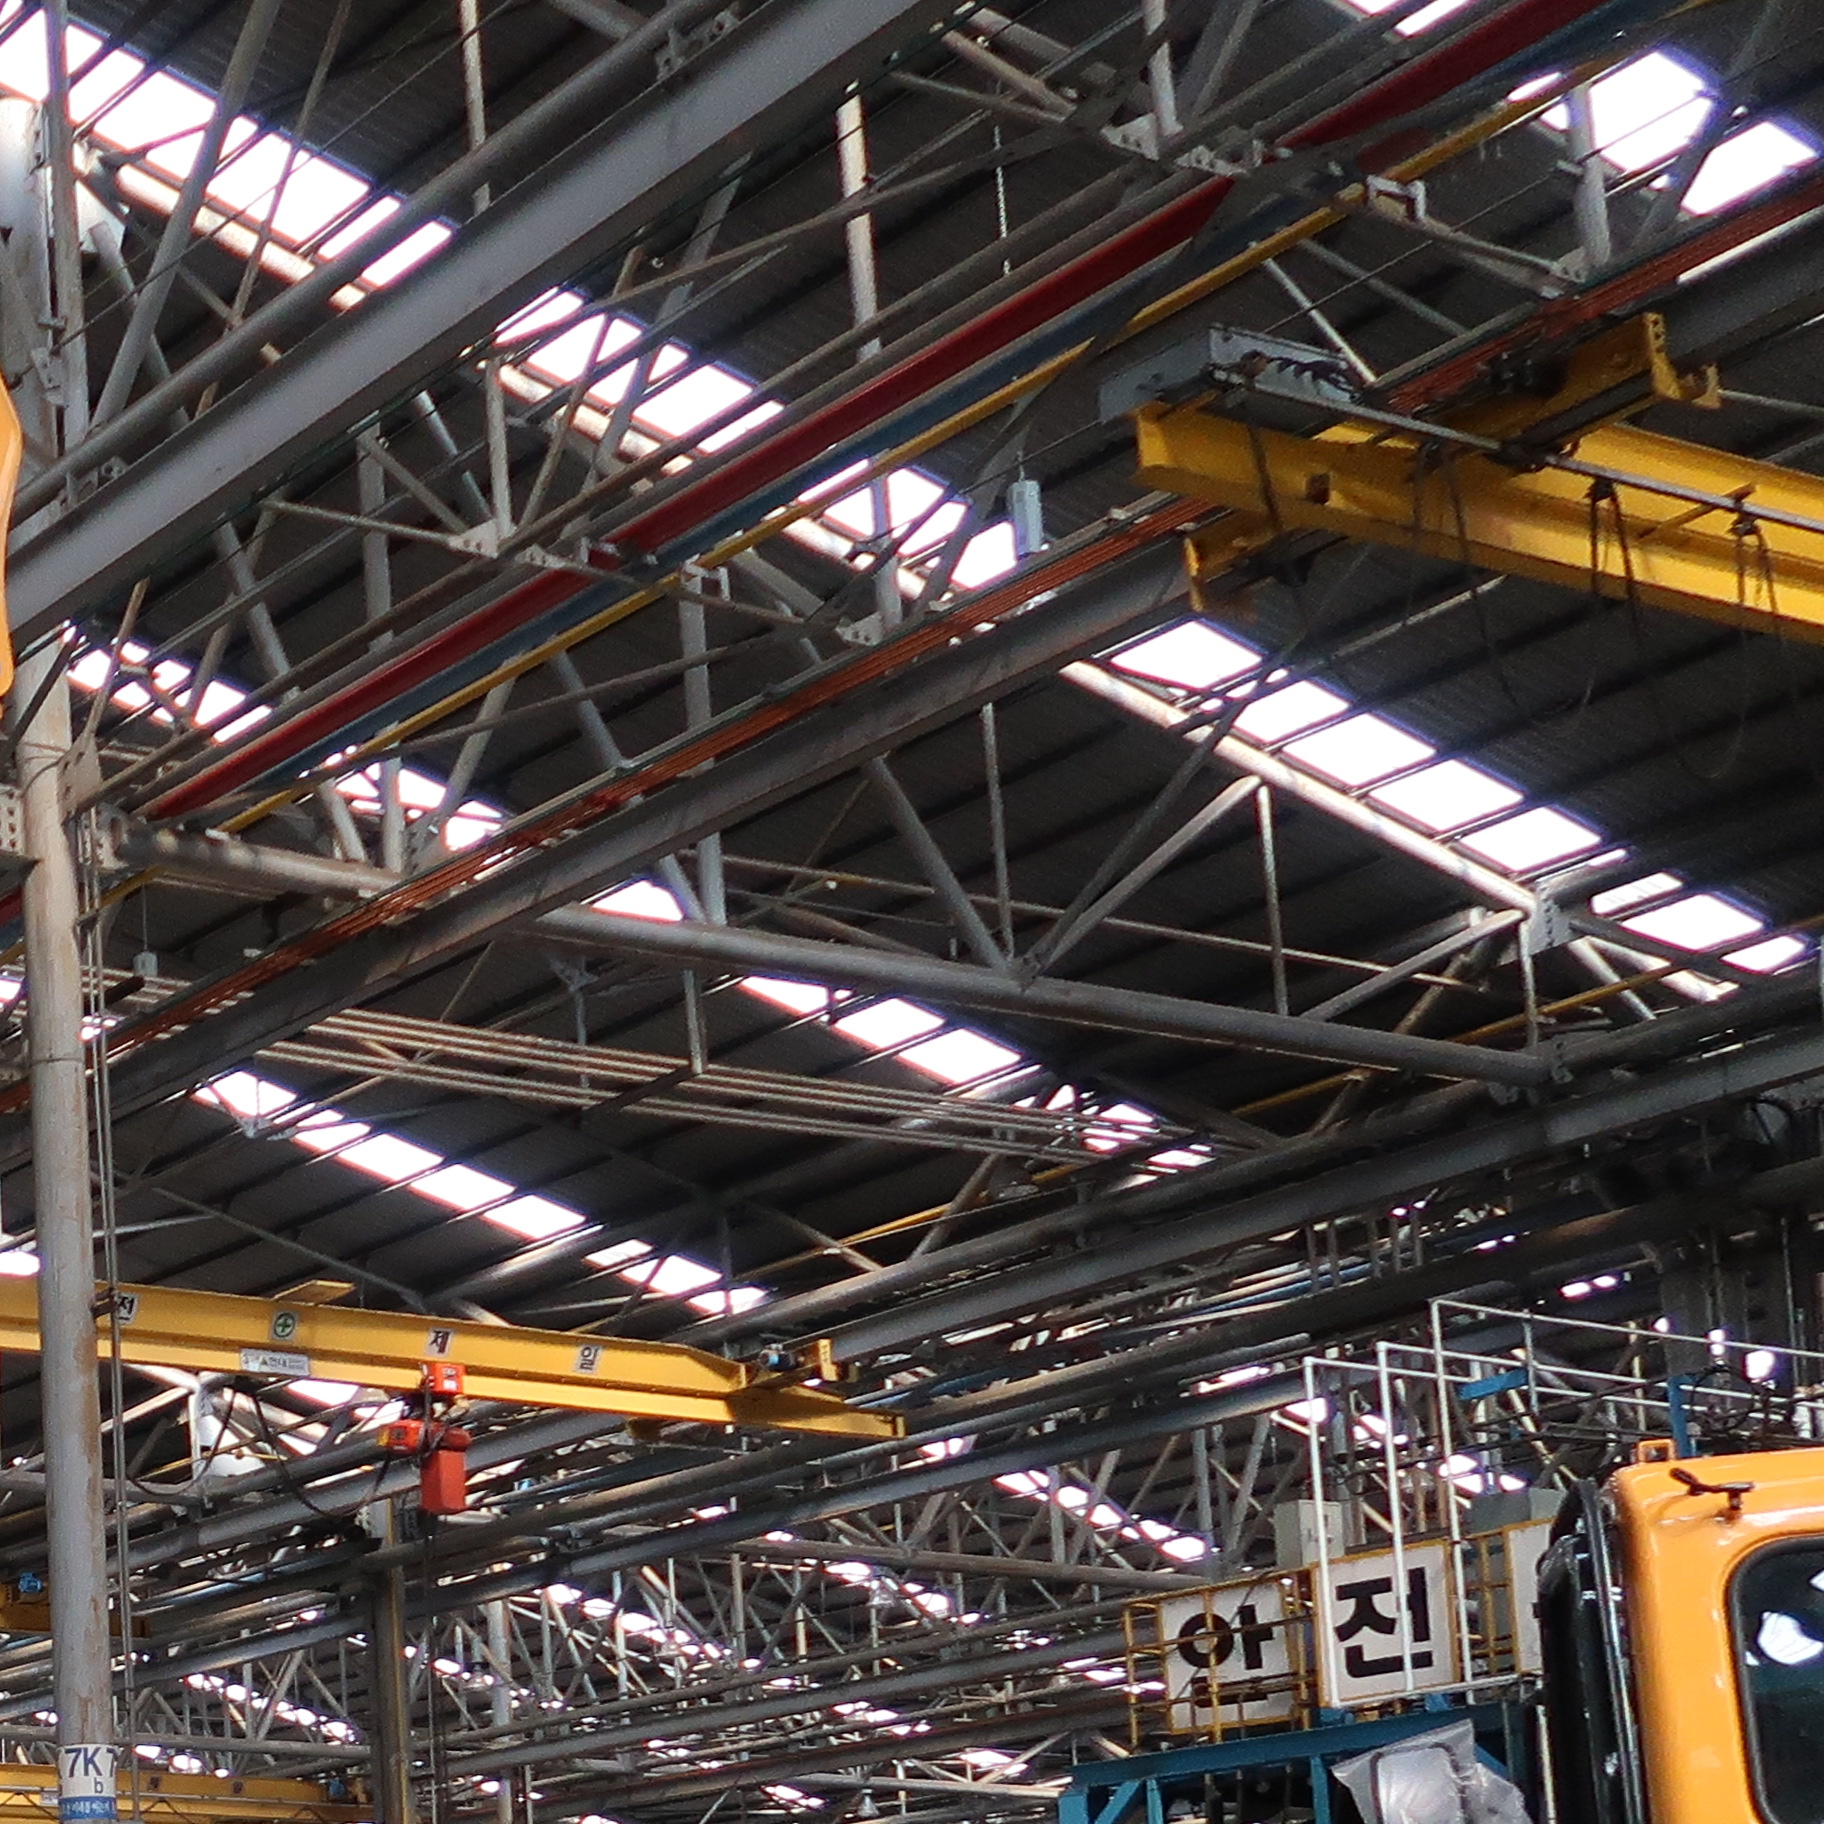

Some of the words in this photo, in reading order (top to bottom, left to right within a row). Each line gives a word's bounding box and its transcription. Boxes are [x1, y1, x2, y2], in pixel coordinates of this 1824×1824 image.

[429, 1330, 450, 1354] 제
[580, 1346, 598, 1371] 일
[1335, 1567, 1433, 1678] 전
[64, 1747, 103, 1779] 7K
